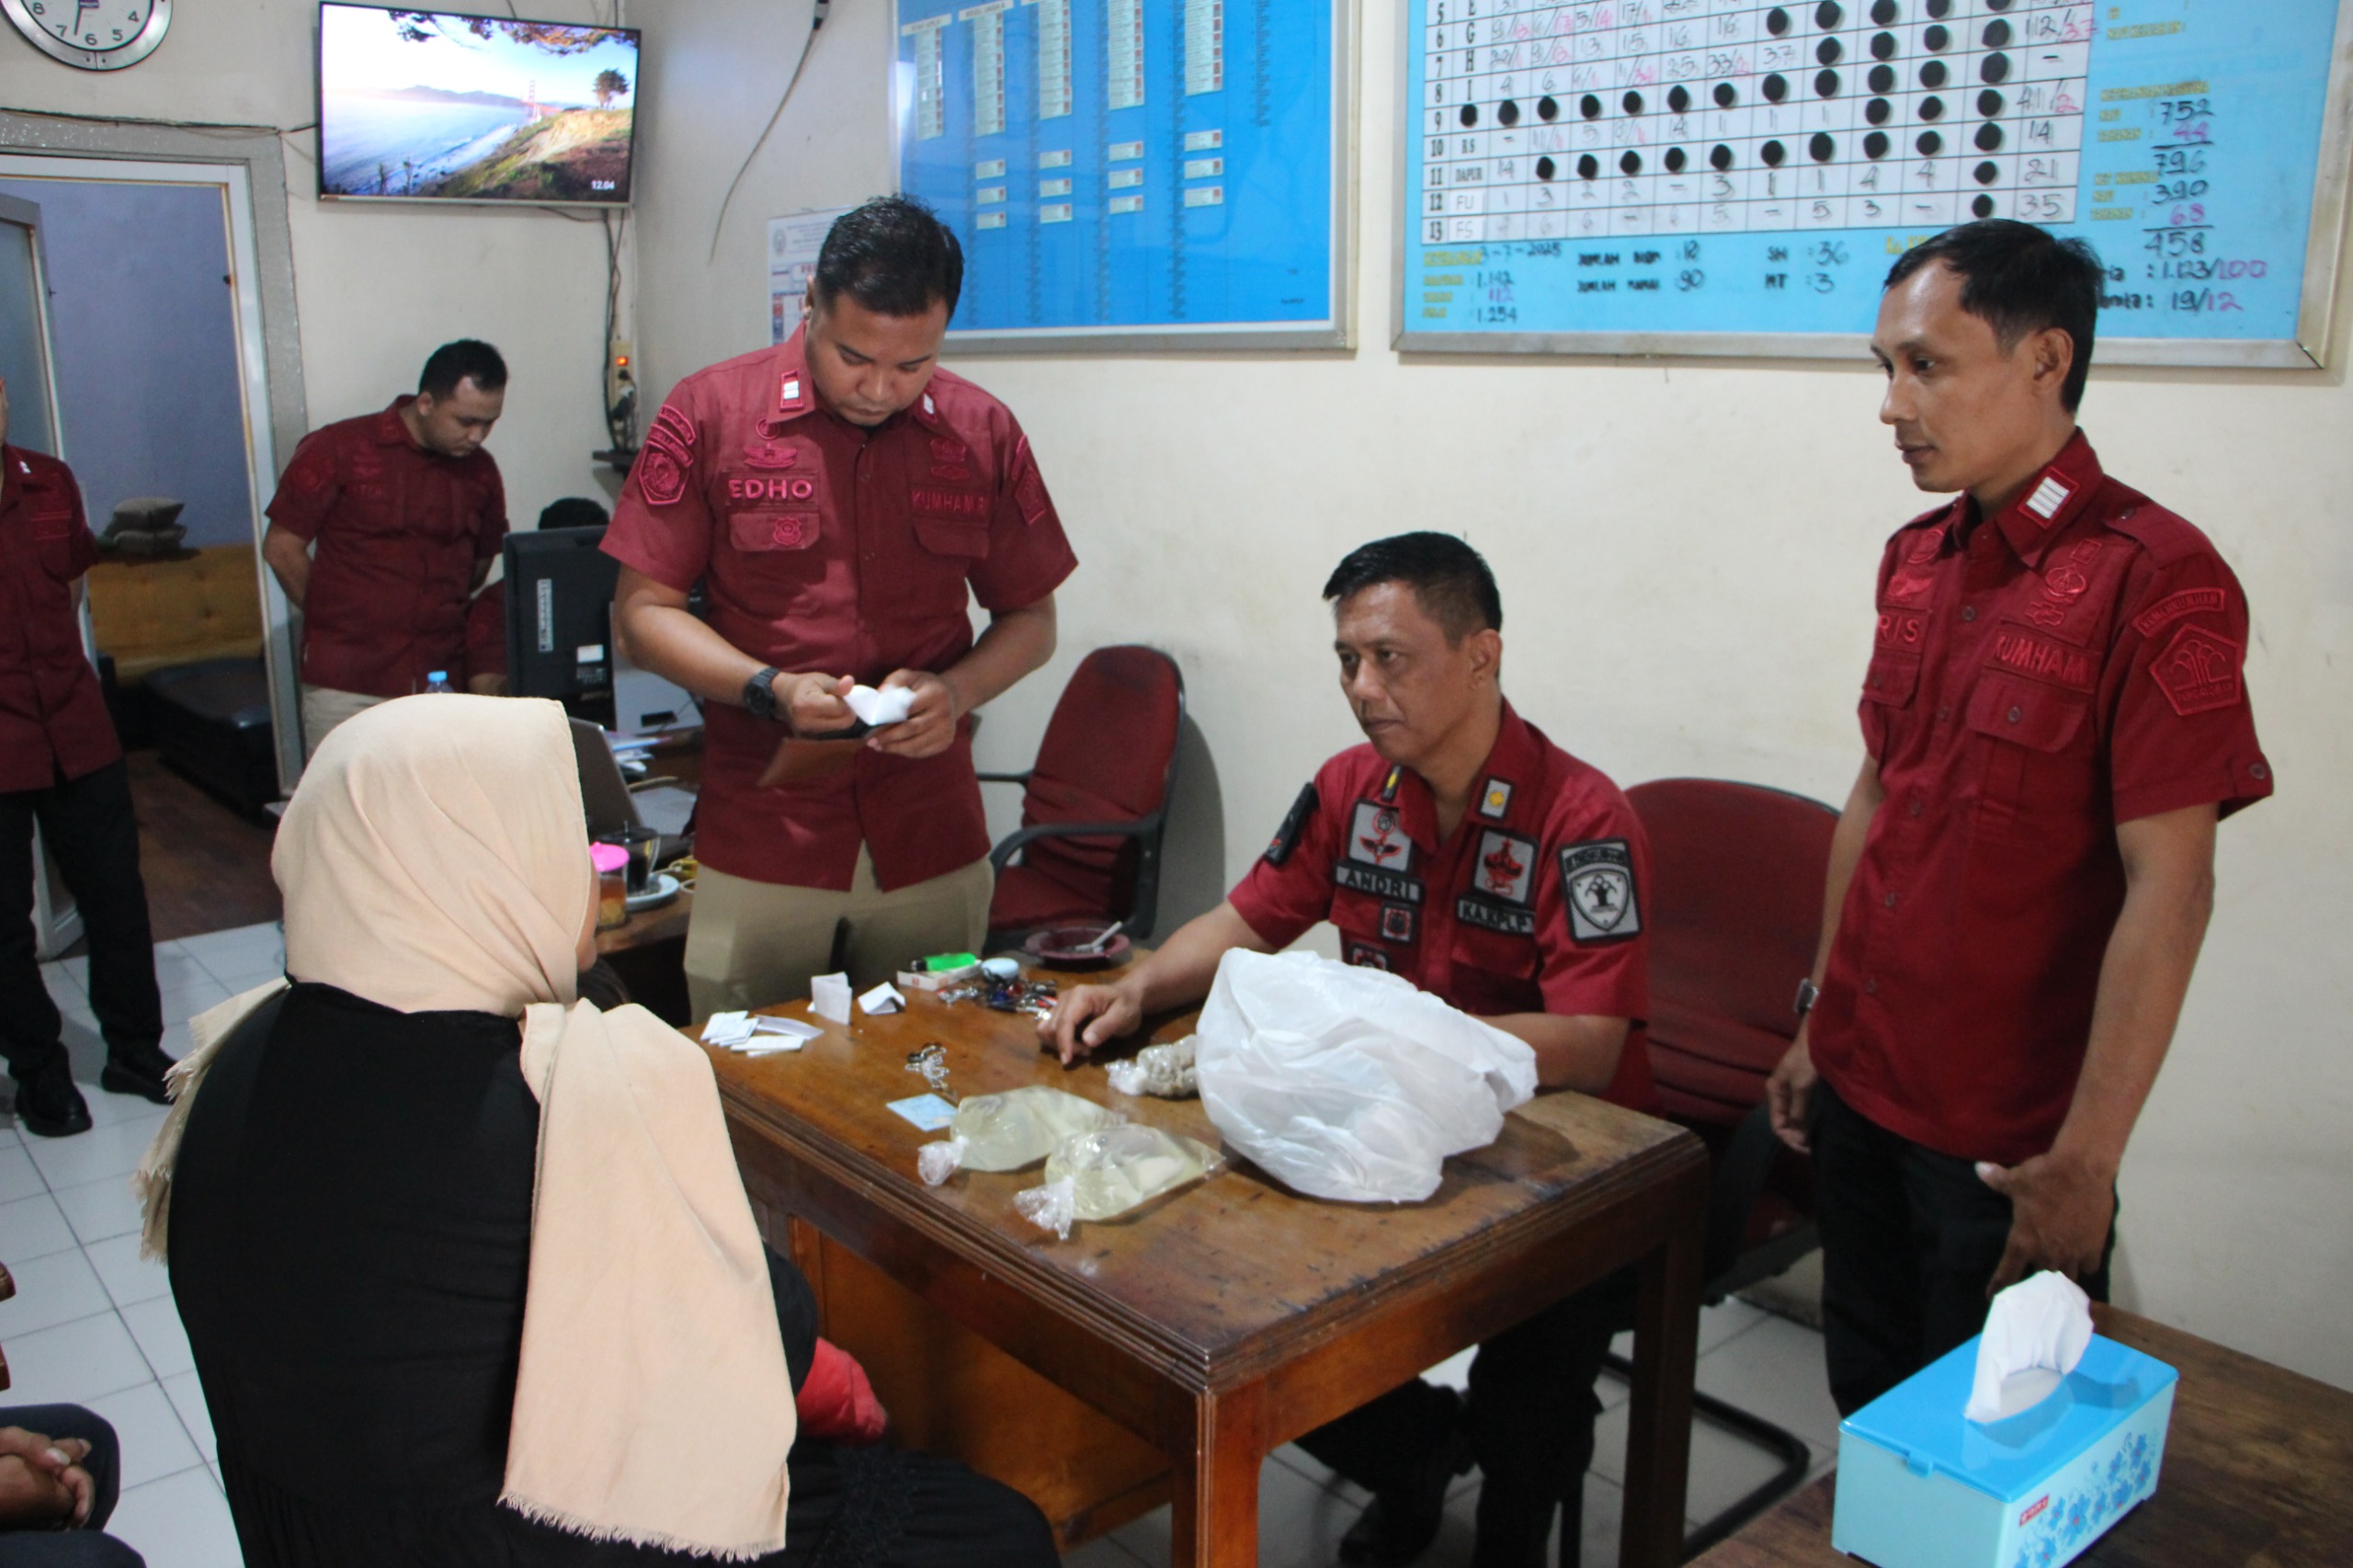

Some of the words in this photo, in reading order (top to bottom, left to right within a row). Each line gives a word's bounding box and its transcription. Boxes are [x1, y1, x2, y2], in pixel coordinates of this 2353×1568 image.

[33, 3, 44, 15] 8
[128, 11, 140, 22] 4
[56, 25, 67, 37] 7
[85, 33, 97, 45] 6
[112, 29, 123, 41] 5
[1436, 28, 1443, 48] 6
[1436, 56, 1443, 77] 7
[1465, 49, 1474, 72] H
[1436, 84, 1442, 103] 8
[1435, 111, 1441, 131] 9
[2160, 98, 2214, 125] 752
[2029, 119, 2051, 144] 14
[1431, 139, 1443, 156] 10
[2024, 158, 2056, 182] 21
[2154, 150, 2207, 176] 796
[1430, 168, 1442, 185] 11
[1859, 165, 1879, 190] 4
[1916, 160, 1935, 187] 4
[1711, 175, 1733, 198] 3
[2152, 180, 2209, 204] 390
[1430, 193, 1442, 211] 12
[1813, 200, 1831, 221] 5
[1864, 199, 1882, 217] 3
[2020, 194, 2063, 217] 35
[2170, 203, 2205, 225] 68
[1430, 221, 1442, 241] 13
[2143, 232, 2204, 257] 458
[728, 479, 813, 499] EDHO
[1345, 869, 1409, 900] ANDRI
